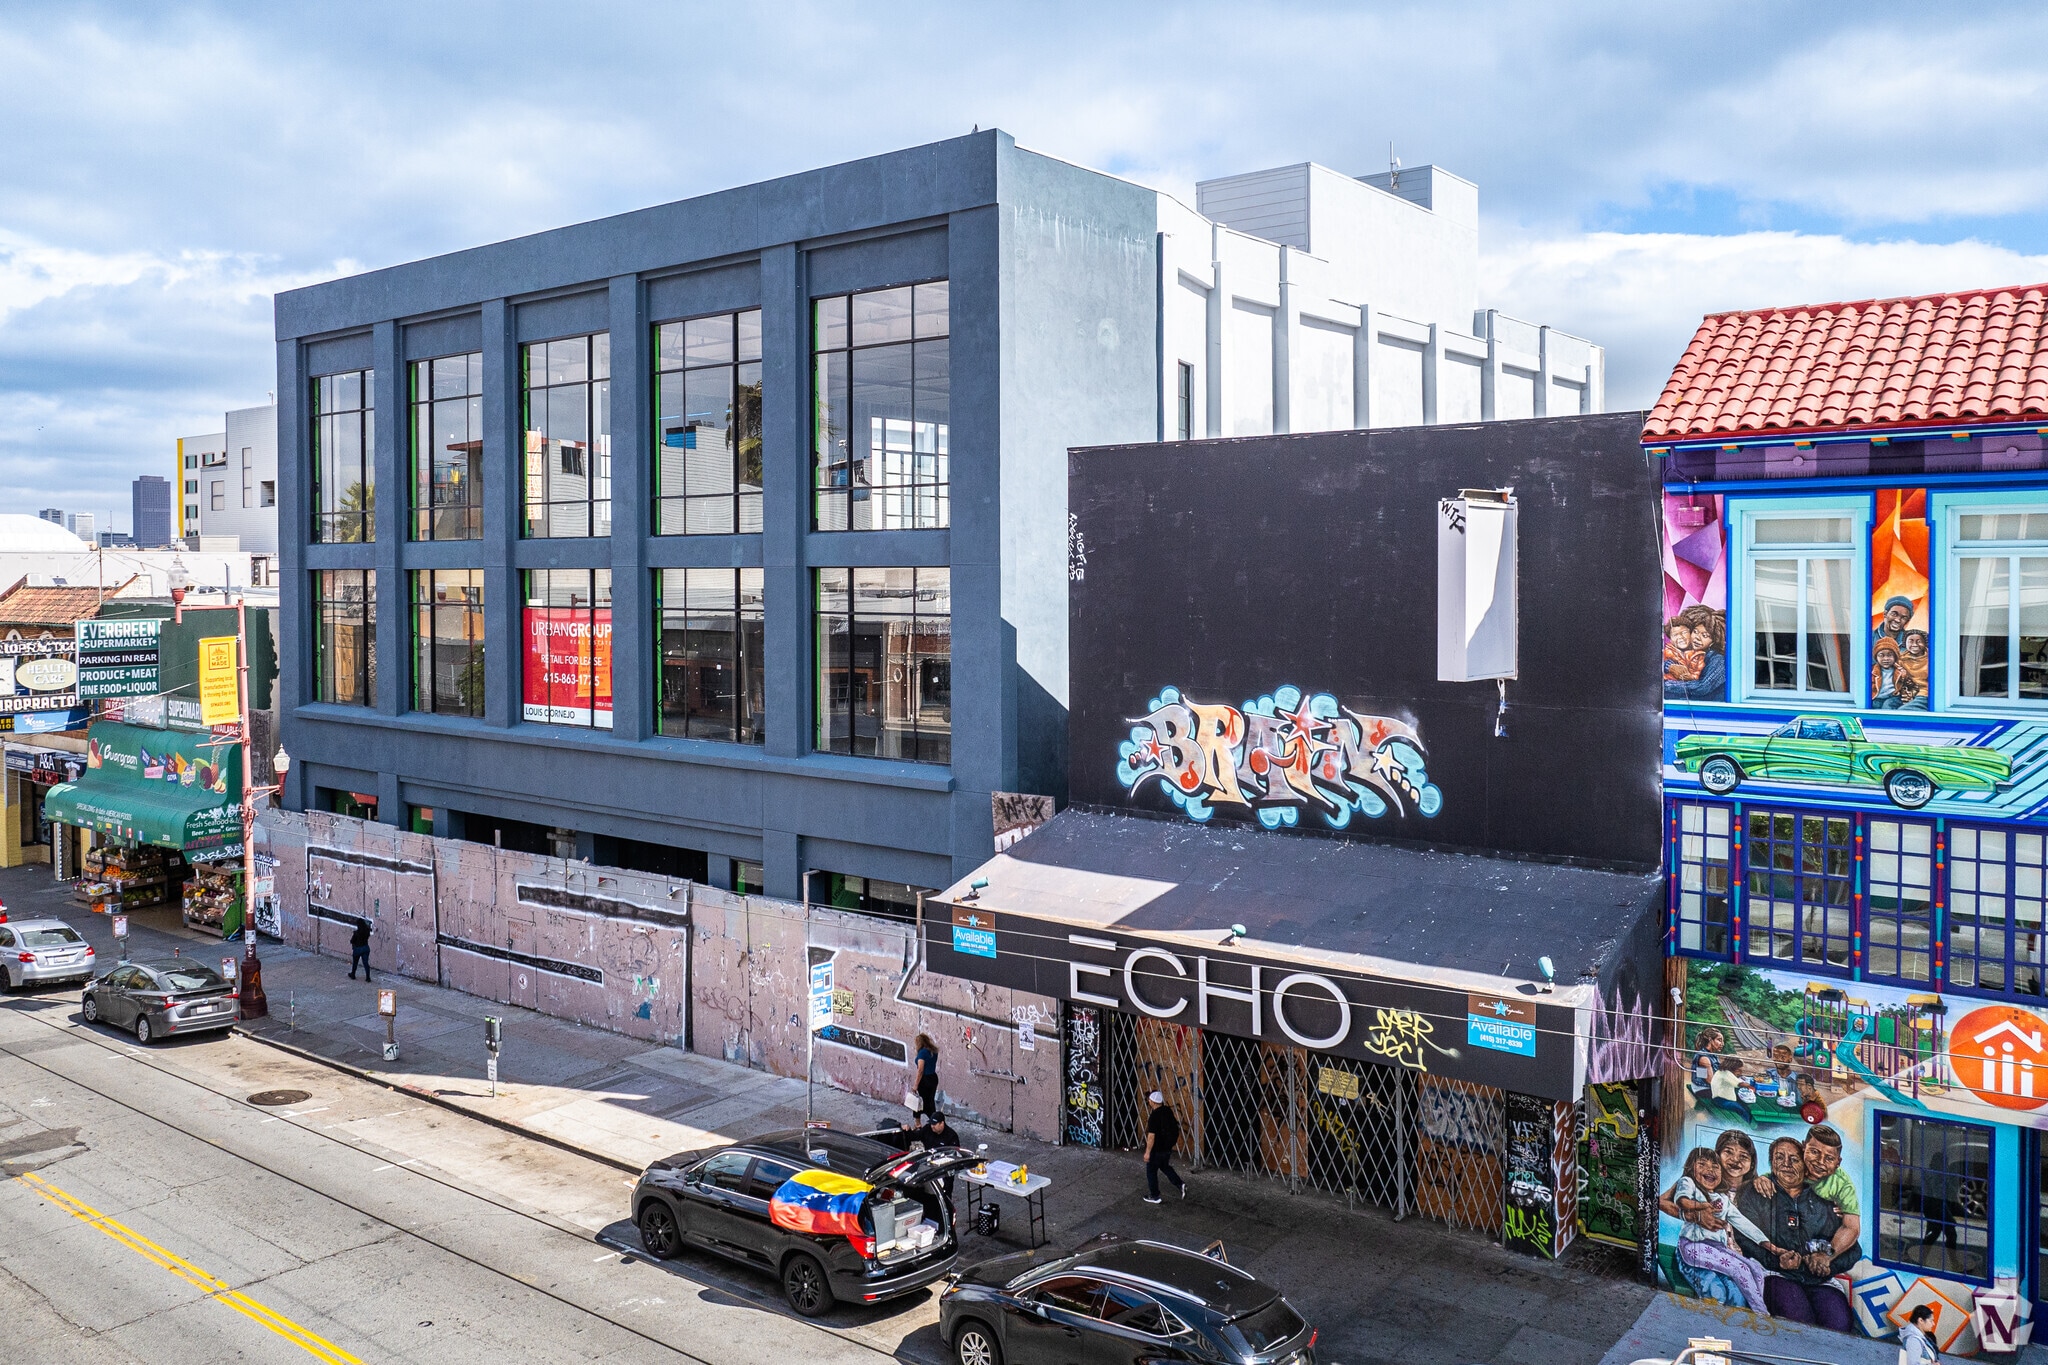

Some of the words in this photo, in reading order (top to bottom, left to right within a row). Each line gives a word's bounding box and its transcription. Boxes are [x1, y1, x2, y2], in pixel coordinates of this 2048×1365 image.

[80, 621, 156, 639] EVERGREEN
[84, 638, 153, 649] SUPERMARKET
[79, 655, 121, 664] PARKING
[133, 653, 157, 662] REAR
[541, 654, 563, 665] RETAIL
[564, 657, 579, 666] FOR
[27, 663, 72, 674] HEALTH
[80, 670, 125, 681] PRODUCE
[131, 668, 157, 679] MEAT
[33, 674, 65, 684] CARE
[80, 685, 98, 695] FINE
[100, 683, 122, 694] FOOD
[126, 681, 157, 693] LIQUOR
[525, 706, 543, 717] LOUIS
[39, 753, 56, 770] A&A
[204, 818, 229, 828] Seafood
[955, 929, 994, 946] Available
[1068, 932, 1352, 1049] ECHO
[1471, 1017, 1532, 1041] Available
[1480, 1033, 1495, 1043] (415)
